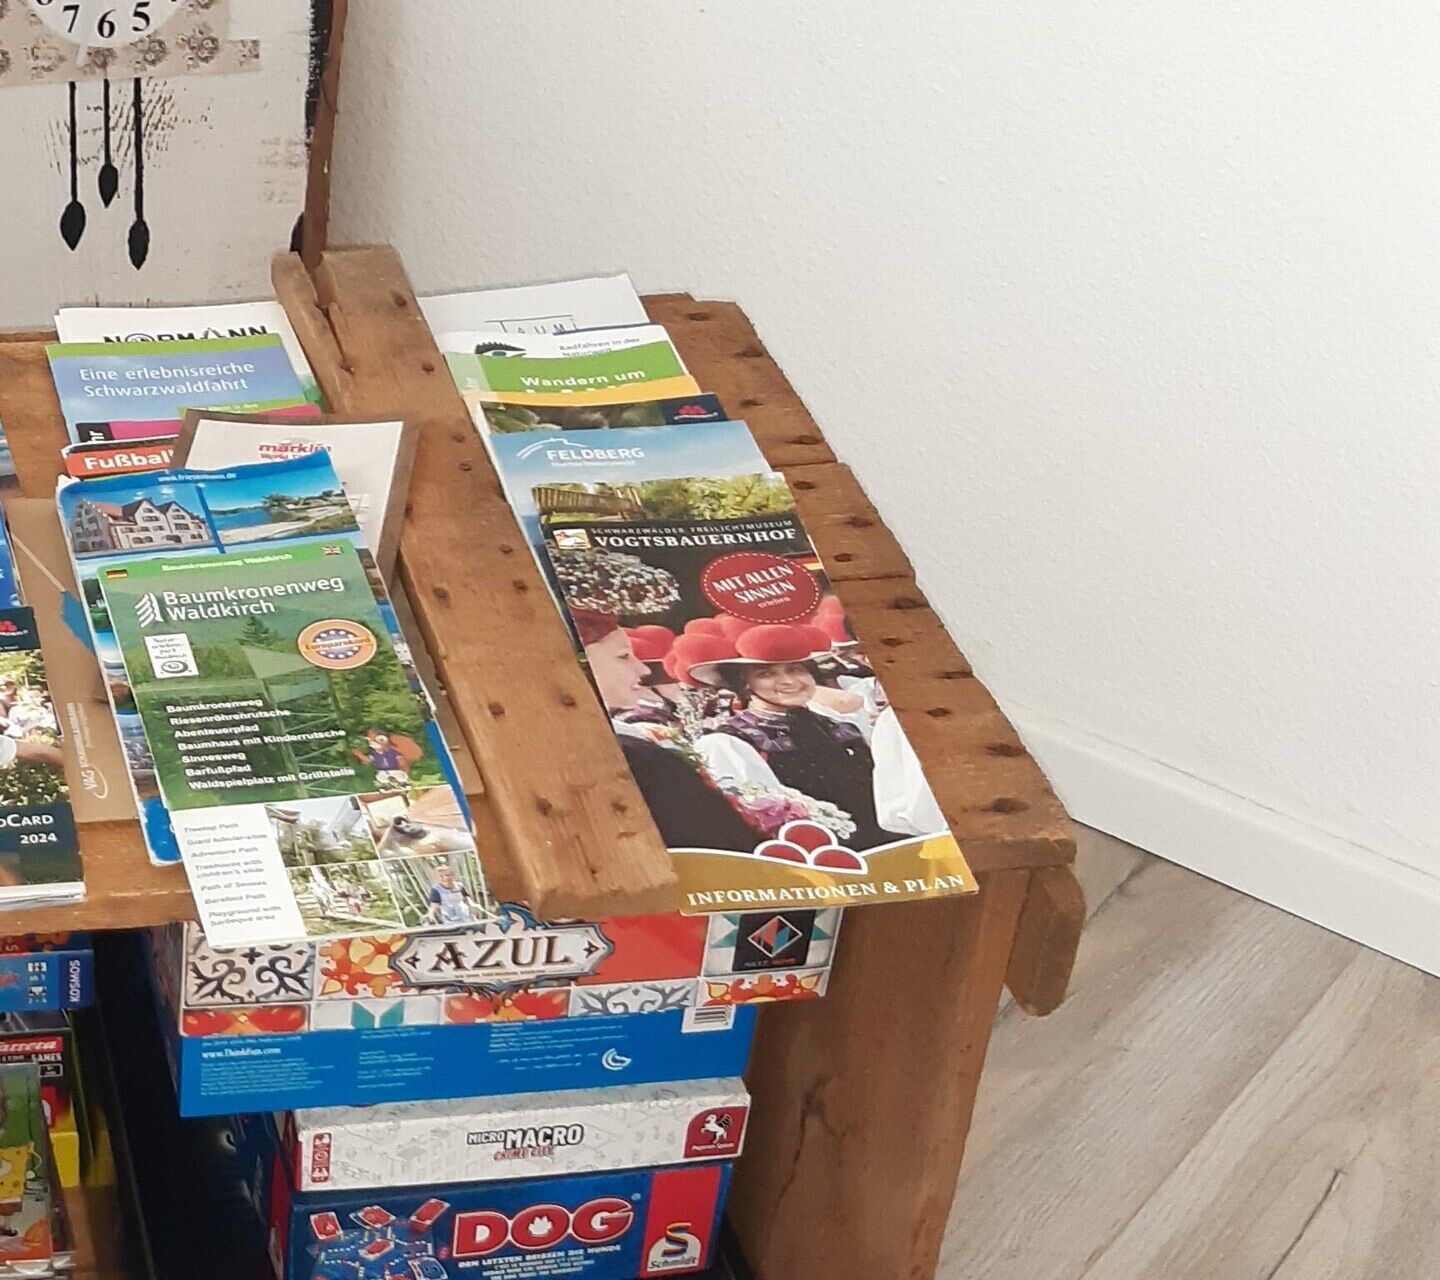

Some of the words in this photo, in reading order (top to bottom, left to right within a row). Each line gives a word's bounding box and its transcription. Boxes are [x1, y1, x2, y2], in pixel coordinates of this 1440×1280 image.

[62, 4, 80, 33] 7
[98, 9, 116, 39] 6
[132, 1, 151, 32] 5
[79, 368, 118, 381] Eine
[125, 361, 255, 381] erlebnisreiche
[520, 373, 608, 388] Wandern
[613, 369, 646, 382] um
[84, 378, 249, 398] Schwarzwaldfahrt
[546, 447, 646, 461] FELDBERG
[594, 528, 796, 549] VOGTSBAUERNHOF
[712, 576, 739, 593] MIT
[739, 564, 795, 587] ALLEN
[163, 576, 345, 606] Baumkronenweg
[734, 580, 796, 605] SINNEN
[166, 600, 276, 621] Waldkirch
[757, 597, 791, 608] erleben
[166, 699, 263, 713] Baumkronenweg
[170, 709, 291, 725] Riesenröhrenrutsche
[174, 724, 259, 738] Abenteuerpfad
[177, 739, 241, 751] Baumhaus
[243, 737, 262, 746] mit
[264, 729, 346, 744] Kinderrutsche
[181, 752, 246, 763] Sinnesweg
[185, 764, 252, 777] Barfußpfad
[188, 776, 275, 789] Waldspielplatz
[277, 774, 296, 783] mit
[298, 768, 356, 781] Grillstelle
[20, 832, 57, 845] 2024
[687, 882, 877, 907] INFORMATIONEN
[883, 881, 900, 895] &
[904, 874, 965, 892] PLAN
[428, 935, 572, 972] AZUL
[69, 959, 81, 1004] KOSMOS
[452, 1197, 635, 1258] DOG
[458, 1260, 480, 1269] DEN
[481, 1255, 523, 1266] LETZTEN
[568, 1248, 585, 1257] DIE
[587, 1244, 622, 1254] HUNDE
[649, 1257, 698, 1269] Schmidt
